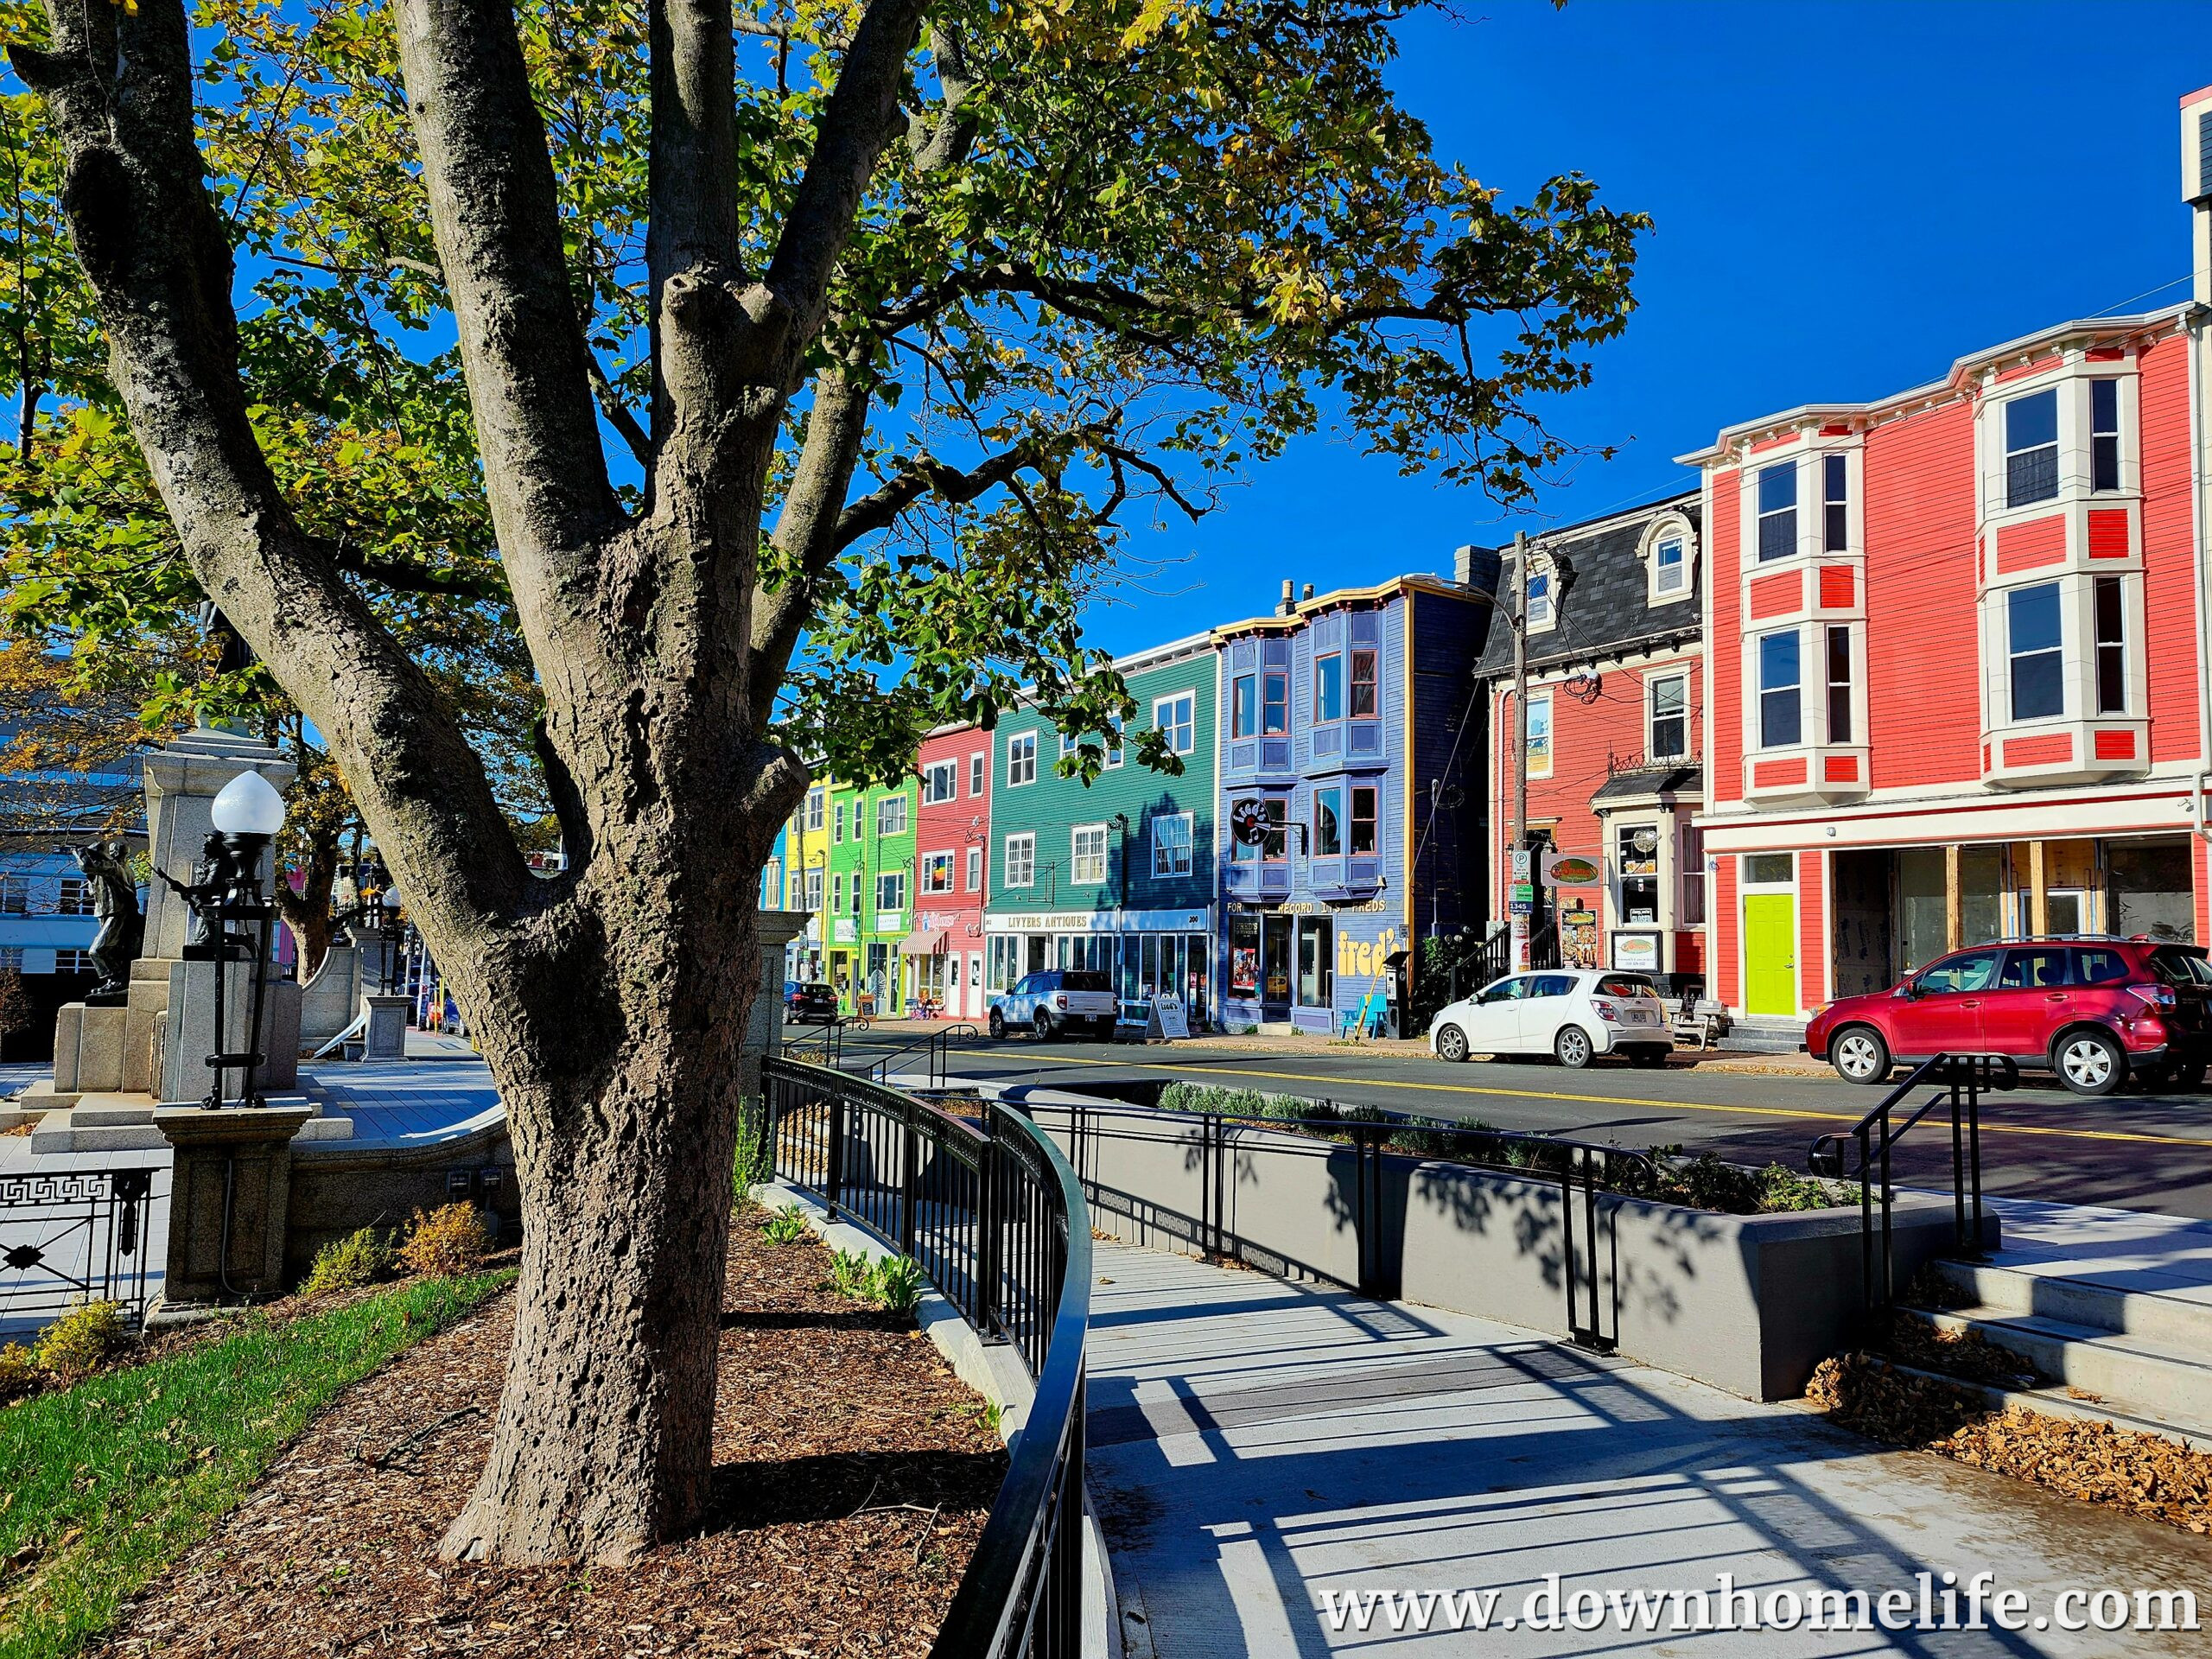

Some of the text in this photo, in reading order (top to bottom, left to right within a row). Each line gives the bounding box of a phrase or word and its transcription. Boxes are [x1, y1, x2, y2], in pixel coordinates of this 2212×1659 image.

[1233, 803, 1267, 823] fred's
[1227, 902, 1243, 912] FOR
[1278, 902, 1313, 914] RECORD
[1351, 899, 1386, 912] FREDS
[1008, 916, 1087, 928] LIVYERS ANTIQUES
